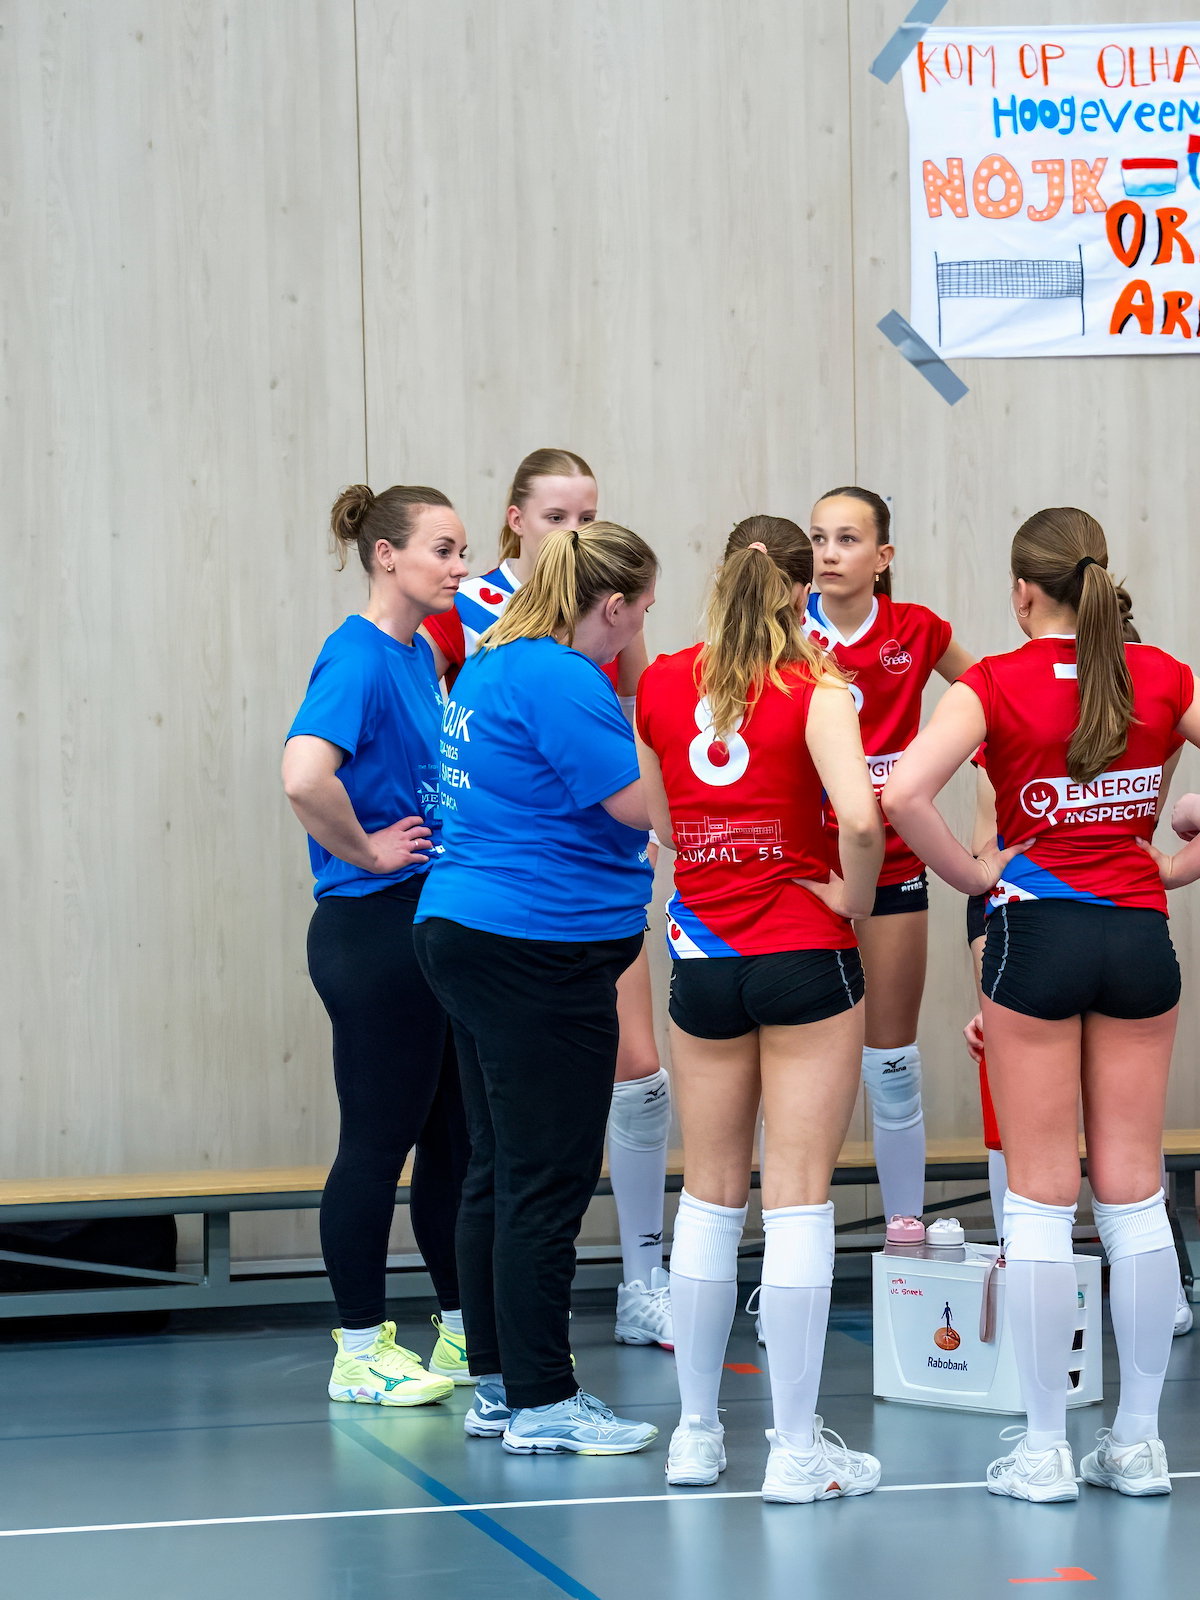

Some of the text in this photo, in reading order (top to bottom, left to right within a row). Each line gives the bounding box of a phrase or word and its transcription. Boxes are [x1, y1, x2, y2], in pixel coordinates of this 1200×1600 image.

[916, 42, 996, 92] KOM
[1019, 43, 1065, 86] OP
[922, 153, 1109, 222] NOJK
[883, 652, 910, 667] Sneek
[688, 692, 750, 787] 8
[1066, 774, 1161, 801] ENERGIE
[1064, 801, 1156, 824] INSPECTIE
[758, 846, 784, 861] 55
[927, 1356, 968, 1371] Rabobank
